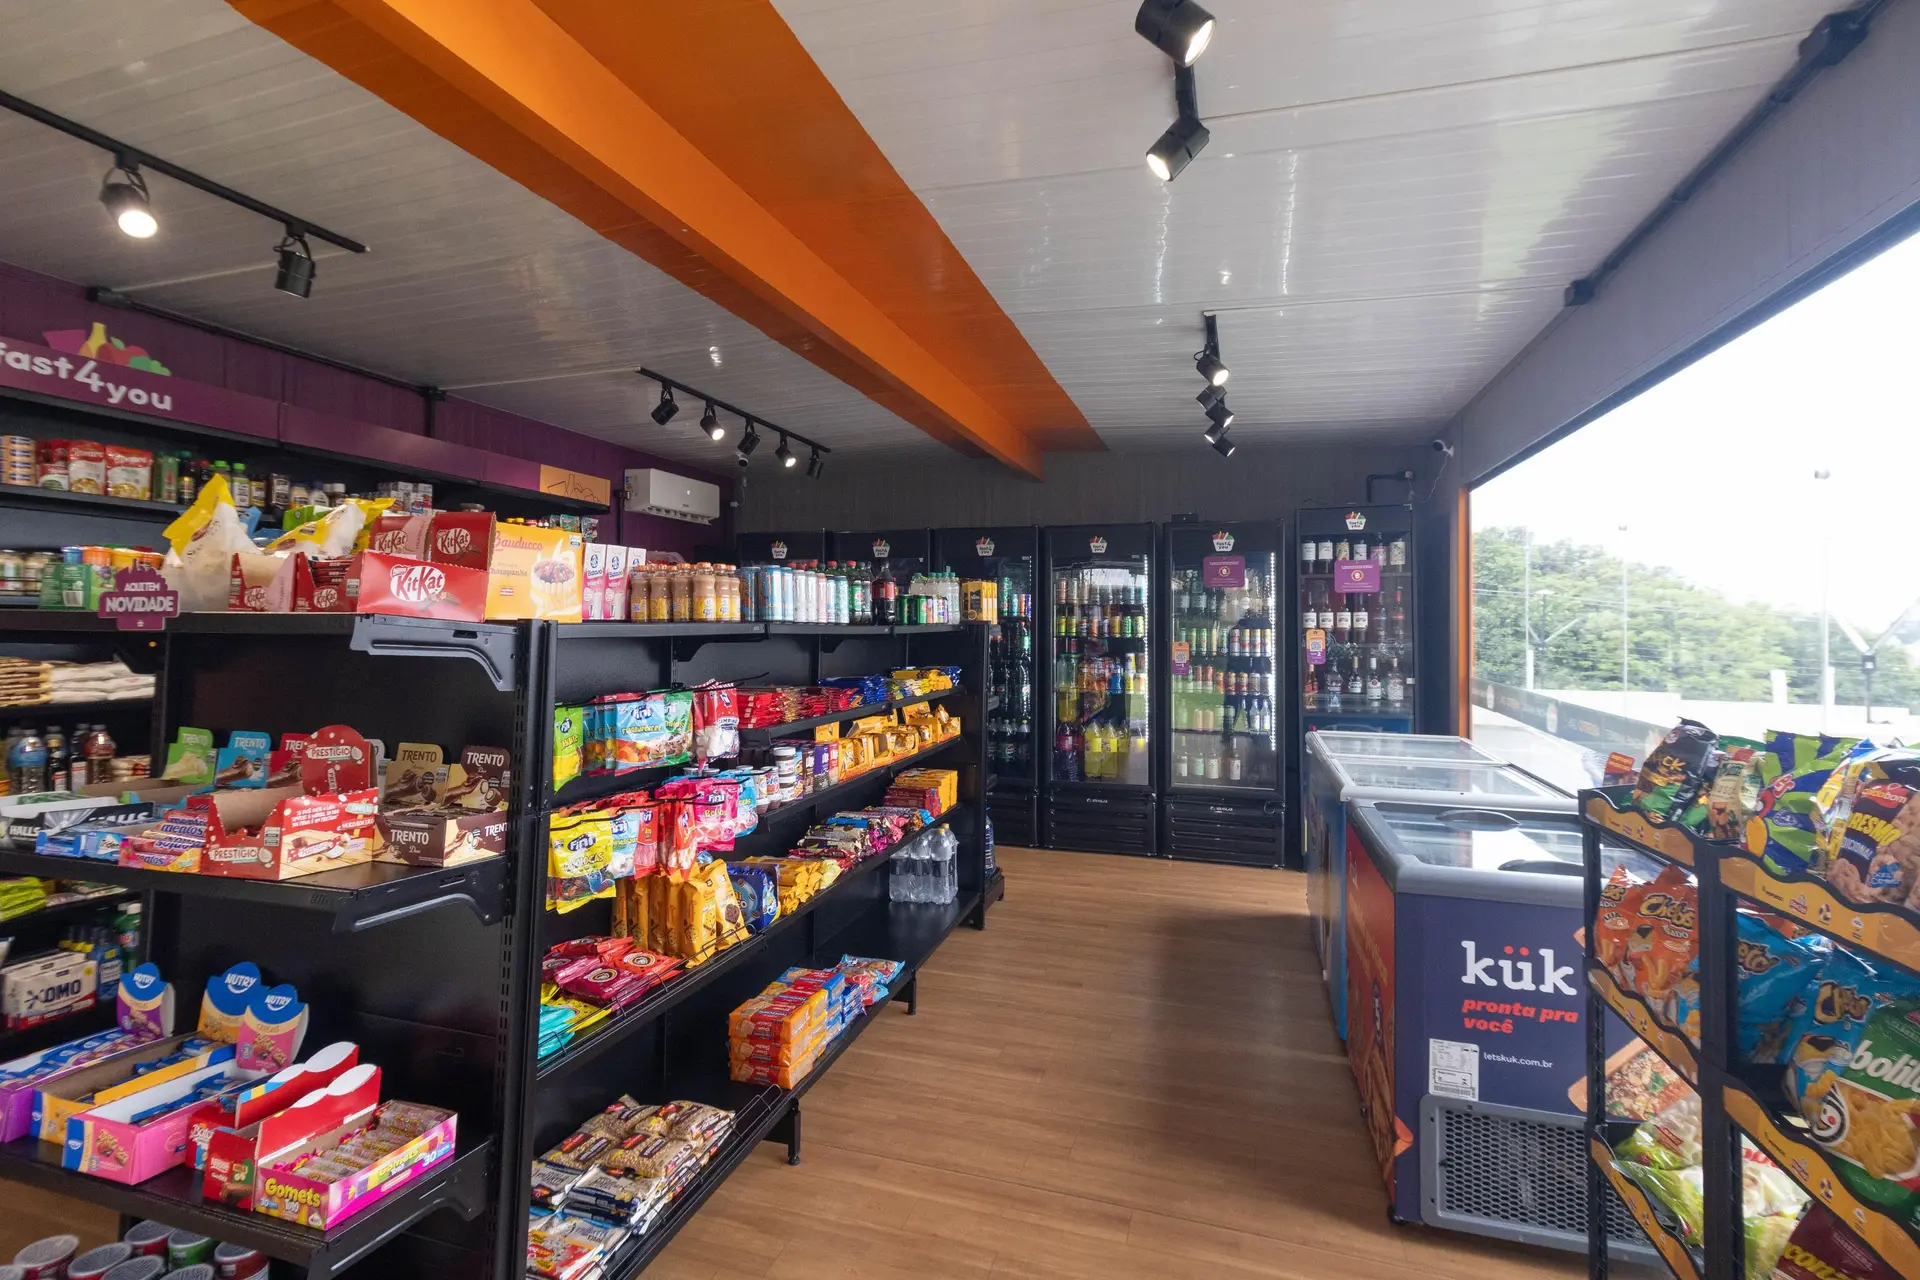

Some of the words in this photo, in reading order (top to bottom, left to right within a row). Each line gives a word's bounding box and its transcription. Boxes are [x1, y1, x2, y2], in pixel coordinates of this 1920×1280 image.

[378, 532, 405, 554] KitKat
[441, 529, 470, 555] KitKat
[396, 566, 444, 601] KitKat
[105, 595, 175, 612] NOVIDADE
[182, 734, 207, 745] TRENTO
[234, 737, 266, 749] TRENTO
[311, 750, 351, 759] PRESTIGIO
[402, 749, 437, 763] TRENTO
[466, 752, 505, 767] TRENTO
[9, 825, 41, 837] HALLS
[161, 824, 203, 838] mentos
[390, 829, 429, 845] TRENTO
[570, 834, 595, 852] Fini
[138, 853, 166, 865] entos
[214, 849, 257, 859] PRESTIGIO
[1461, 940, 1577, 996] kük
[133, 972, 156, 985] NUTRY
[225, 973, 257, 989] NUTRY
[43, 980, 82, 1003] OMO
[265, 994, 292, 1007] NUTRY
[1462, 998, 1536, 1018] pronta
[1539, 1007, 1579, 1024] pra
[1463, 1015, 1514, 1034] você
[1483, 1051, 1554, 1069] letskuk.com.br
[421, 1151, 437, 1168] 30
[265, 1177, 321, 1208] Gomets
